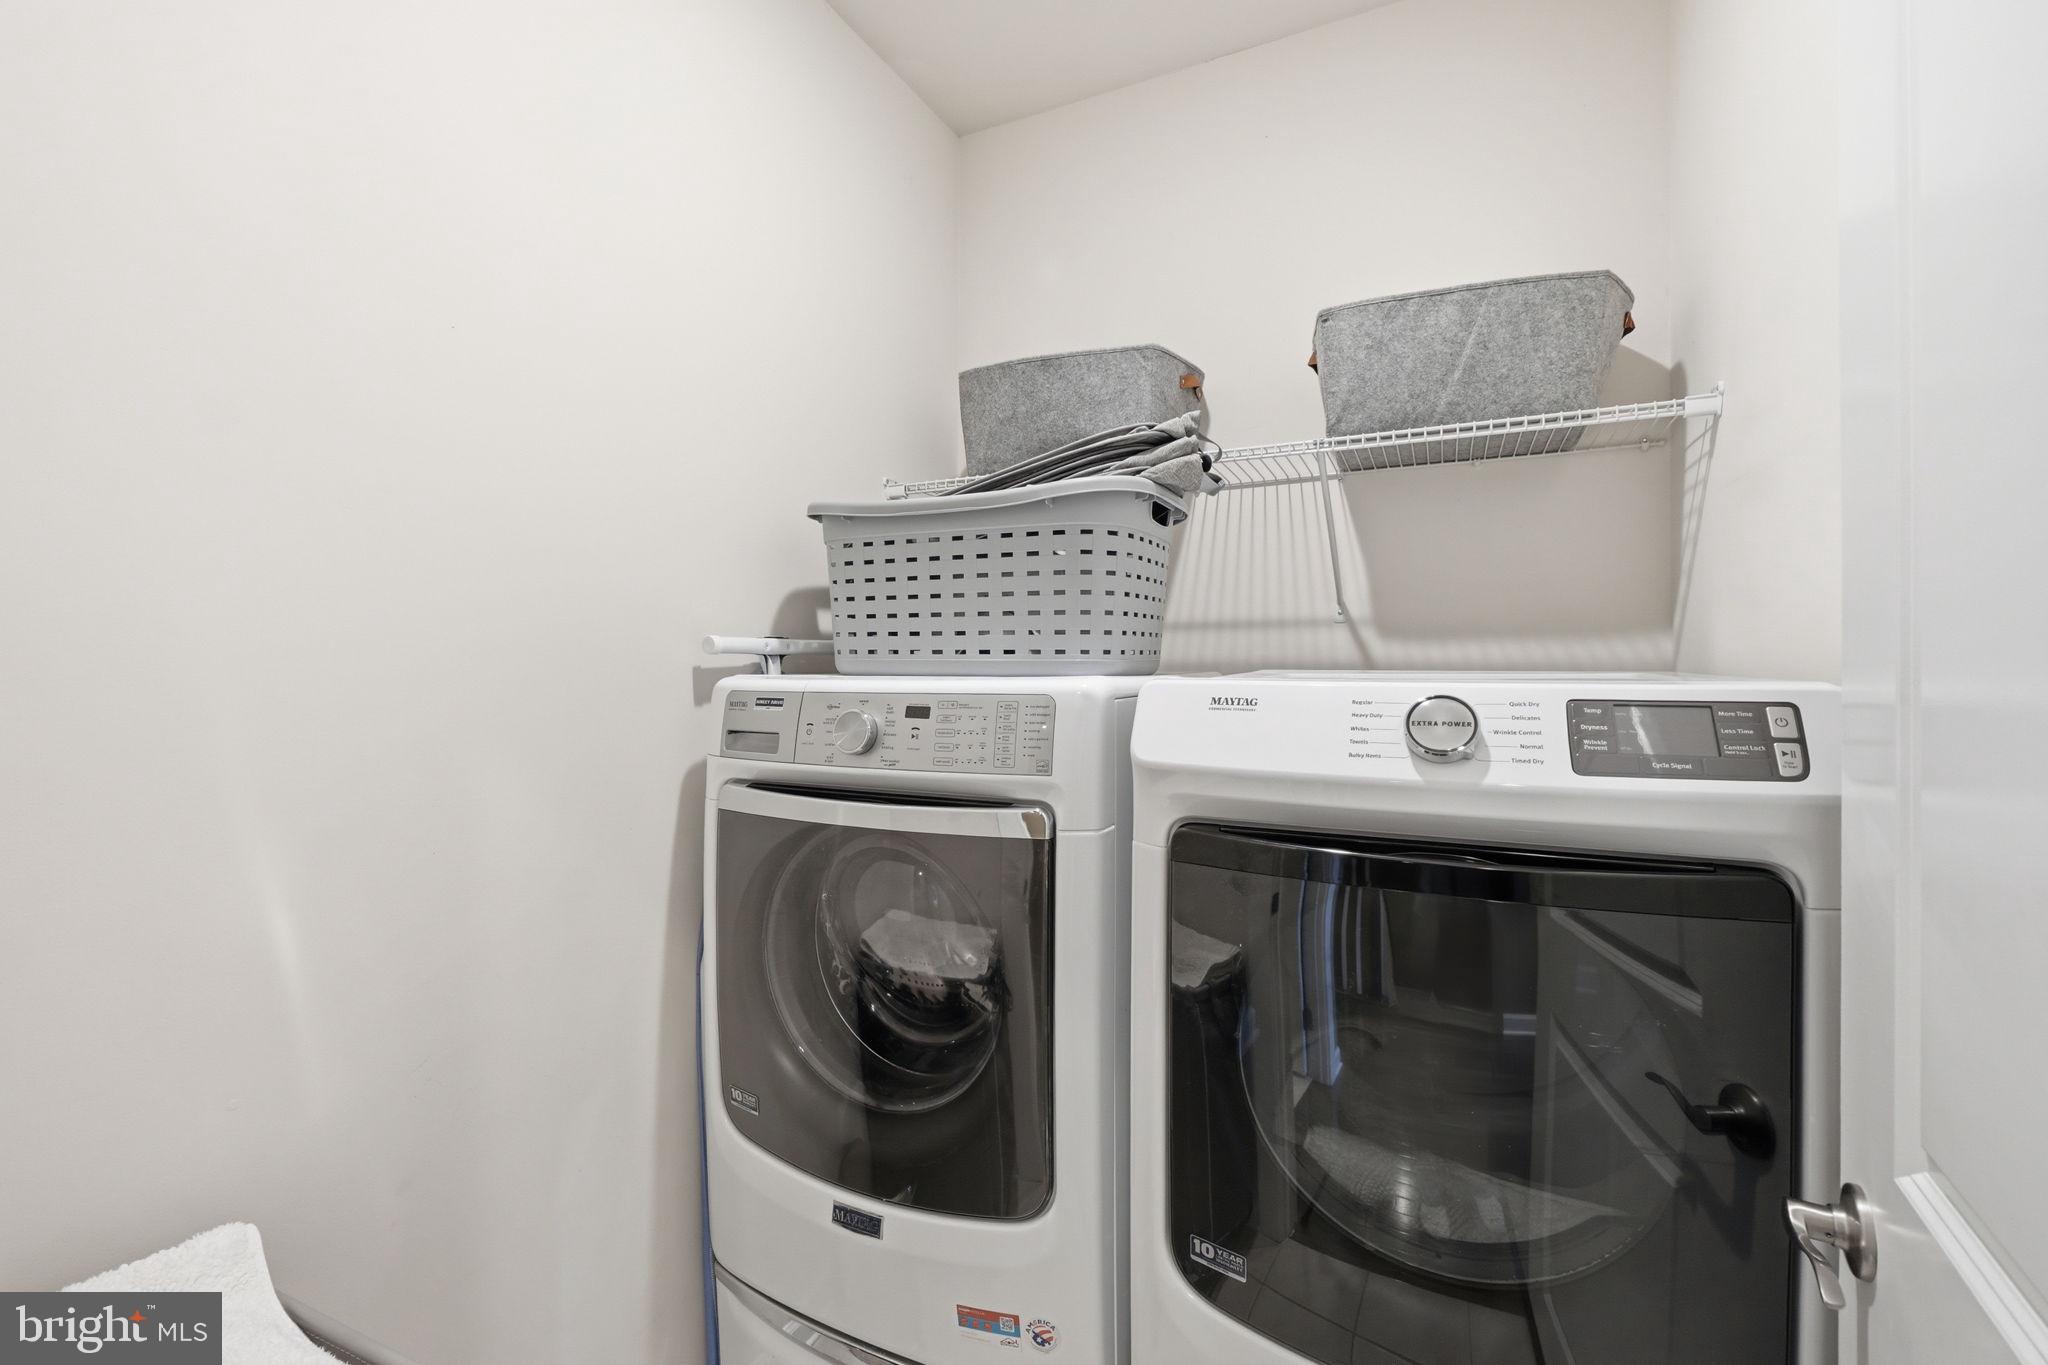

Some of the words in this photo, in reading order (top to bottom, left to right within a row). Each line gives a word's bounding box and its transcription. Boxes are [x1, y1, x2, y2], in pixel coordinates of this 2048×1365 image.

[1210, 696, 1258, 706] MAYTAG
[1580, 723, 1608, 731] Dryness
[1749, 744, 1766, 752] Lock
[1532, 758, 1544, 766] Dry
[1652, 761, 1670, 769] Cycle
[1670, 762, 1693, 770] Signal
[731, 1087, 743, 1102] 10
[1193, 1238, 1215, 1259] 10
[1216, 1248, 1244, 1265] YEAR
